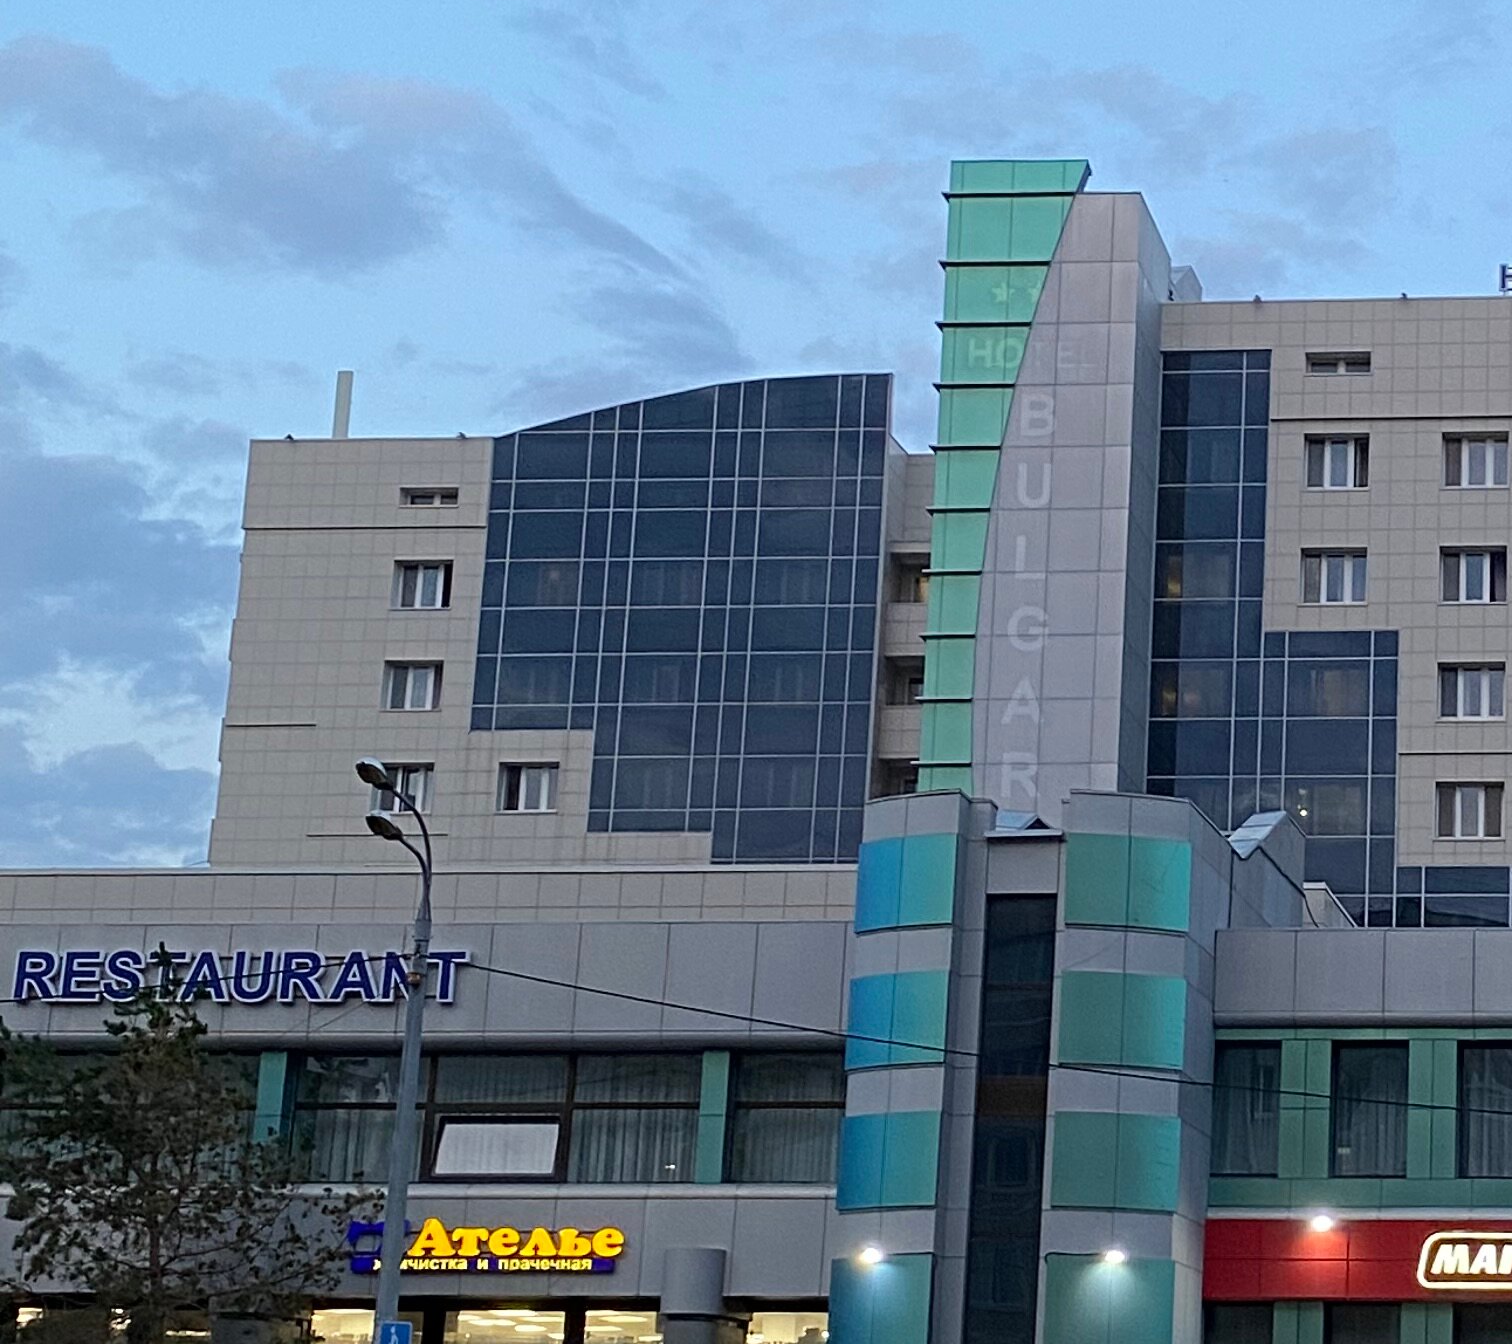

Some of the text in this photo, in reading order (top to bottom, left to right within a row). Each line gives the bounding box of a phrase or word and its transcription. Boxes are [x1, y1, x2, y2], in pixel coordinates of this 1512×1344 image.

[1001, 393, 1055, 799] BULGAR
[13, 950, 469, 1004] RESTAURANT
[407, 1217, 625, 1257] Ателье
[477, 1258, 489, 1270] и
